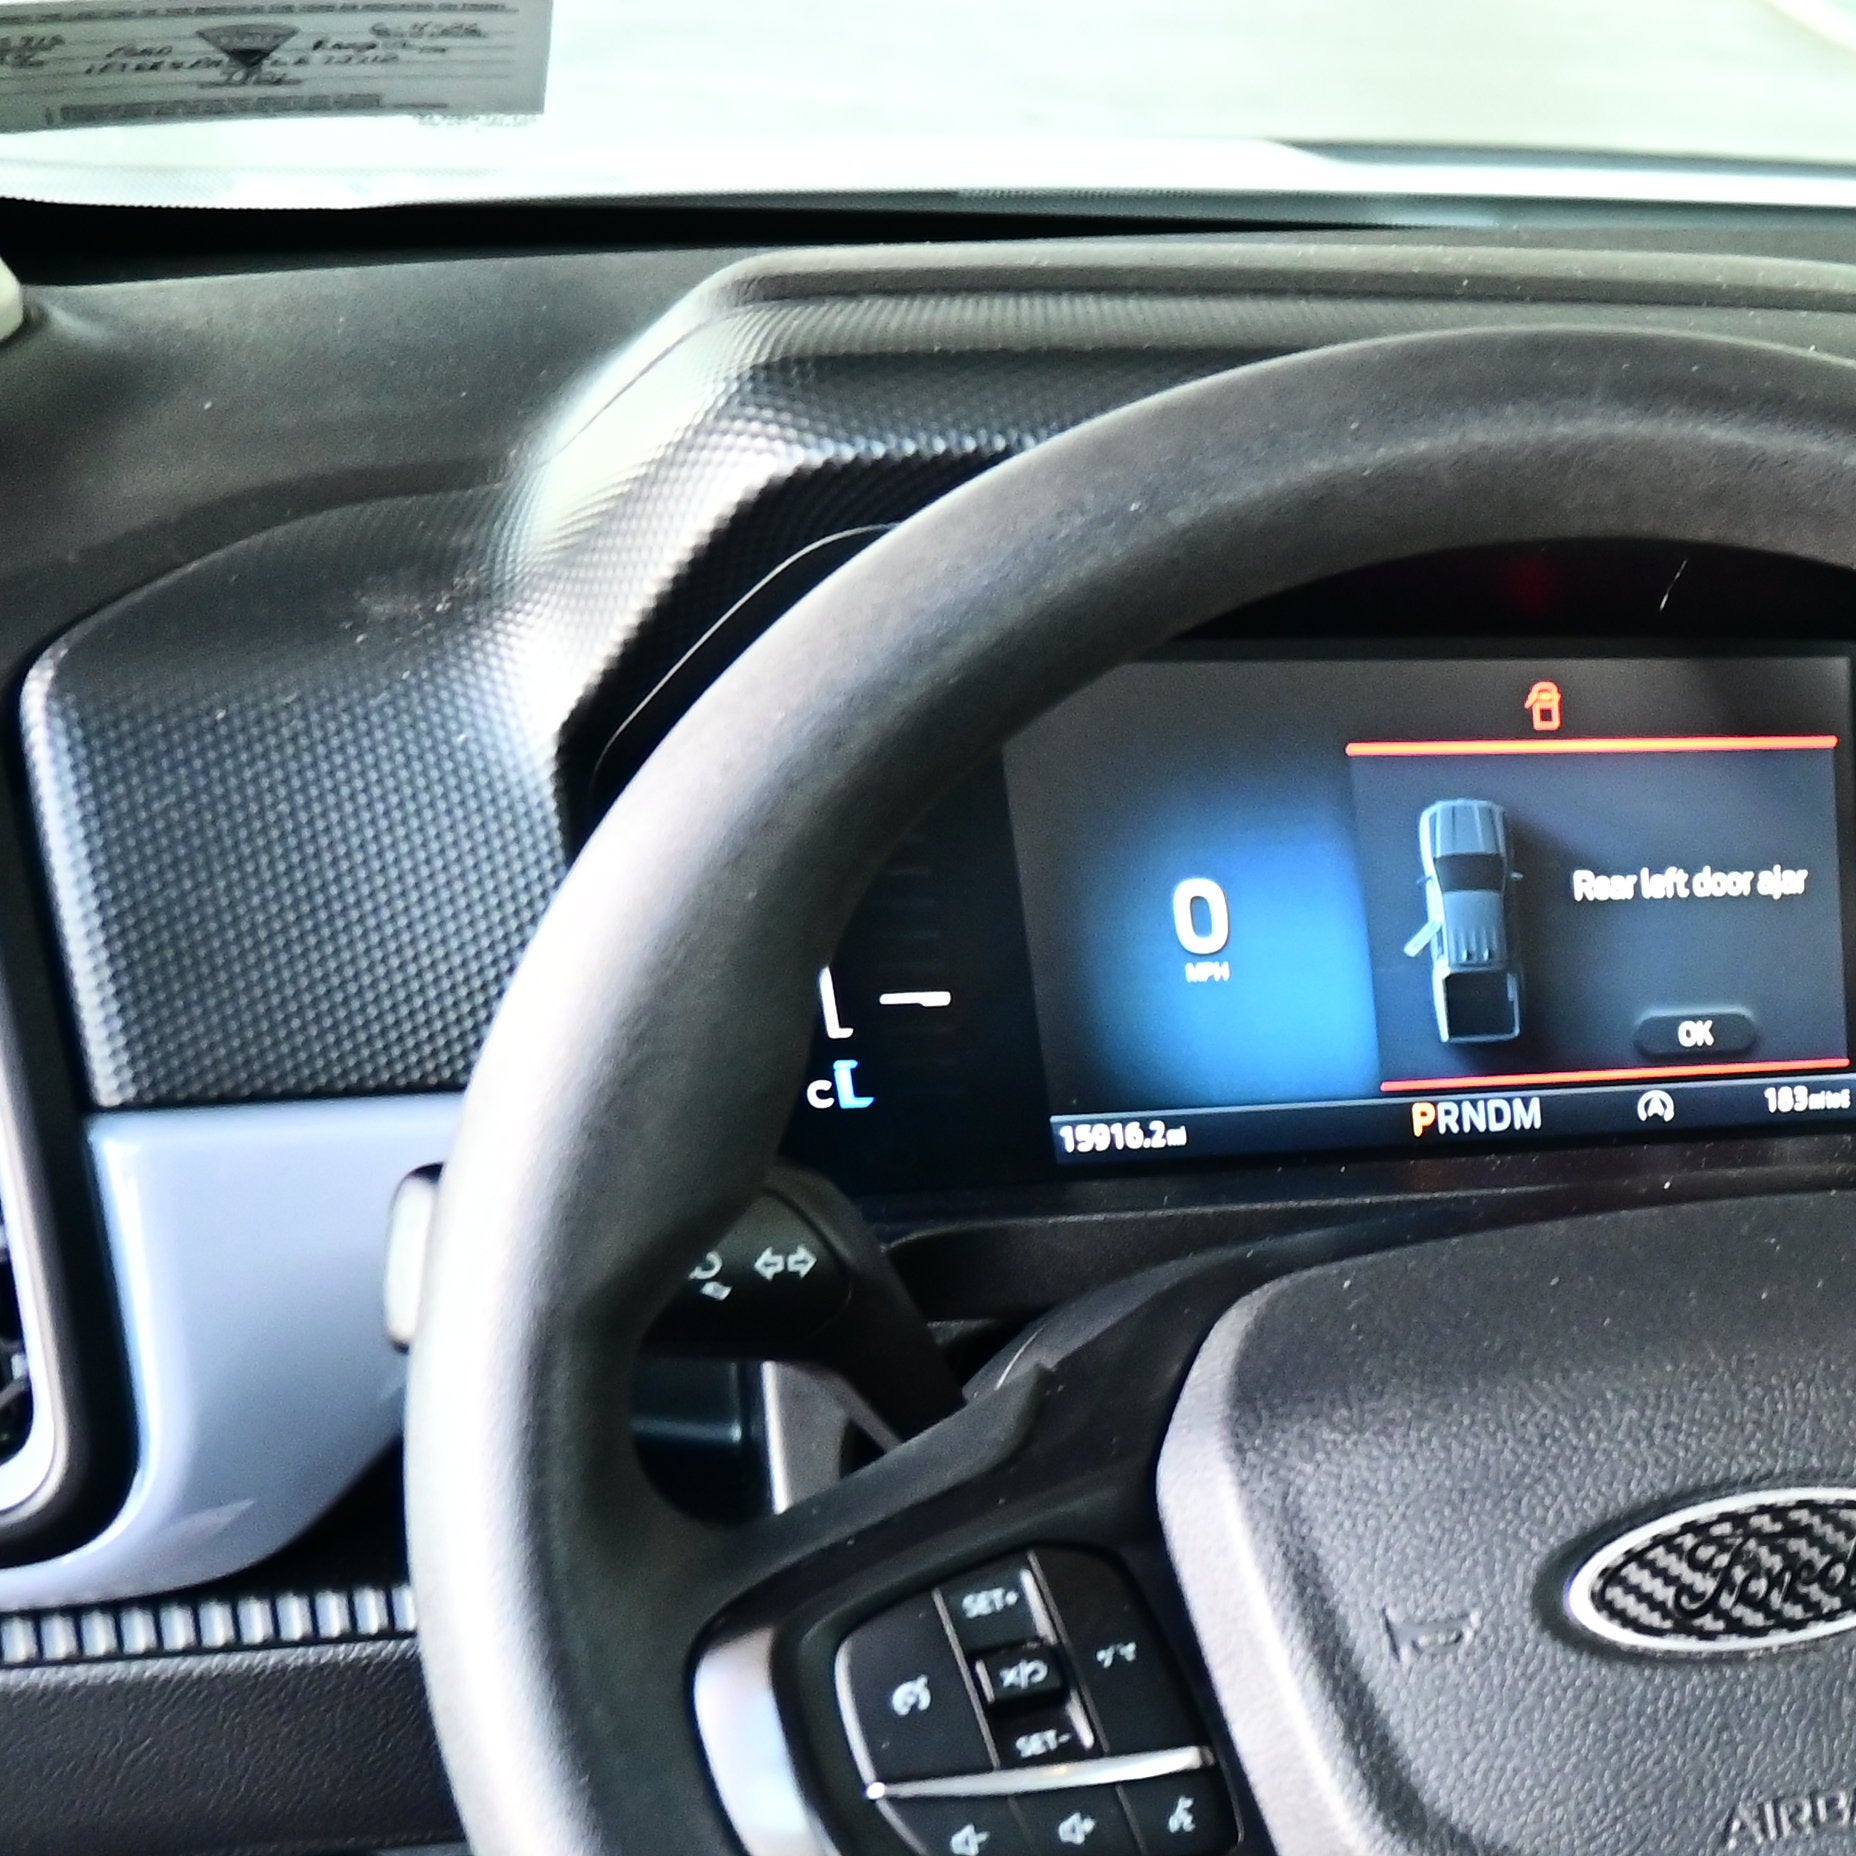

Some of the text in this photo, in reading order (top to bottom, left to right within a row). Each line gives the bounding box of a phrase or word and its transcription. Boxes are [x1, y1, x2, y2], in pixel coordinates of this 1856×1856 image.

[1572, 864, 1809, 902] Rear left door ajar
[1172, 877, 1229, 954] 0
[1676, 1018, 1714, 1048] OK
